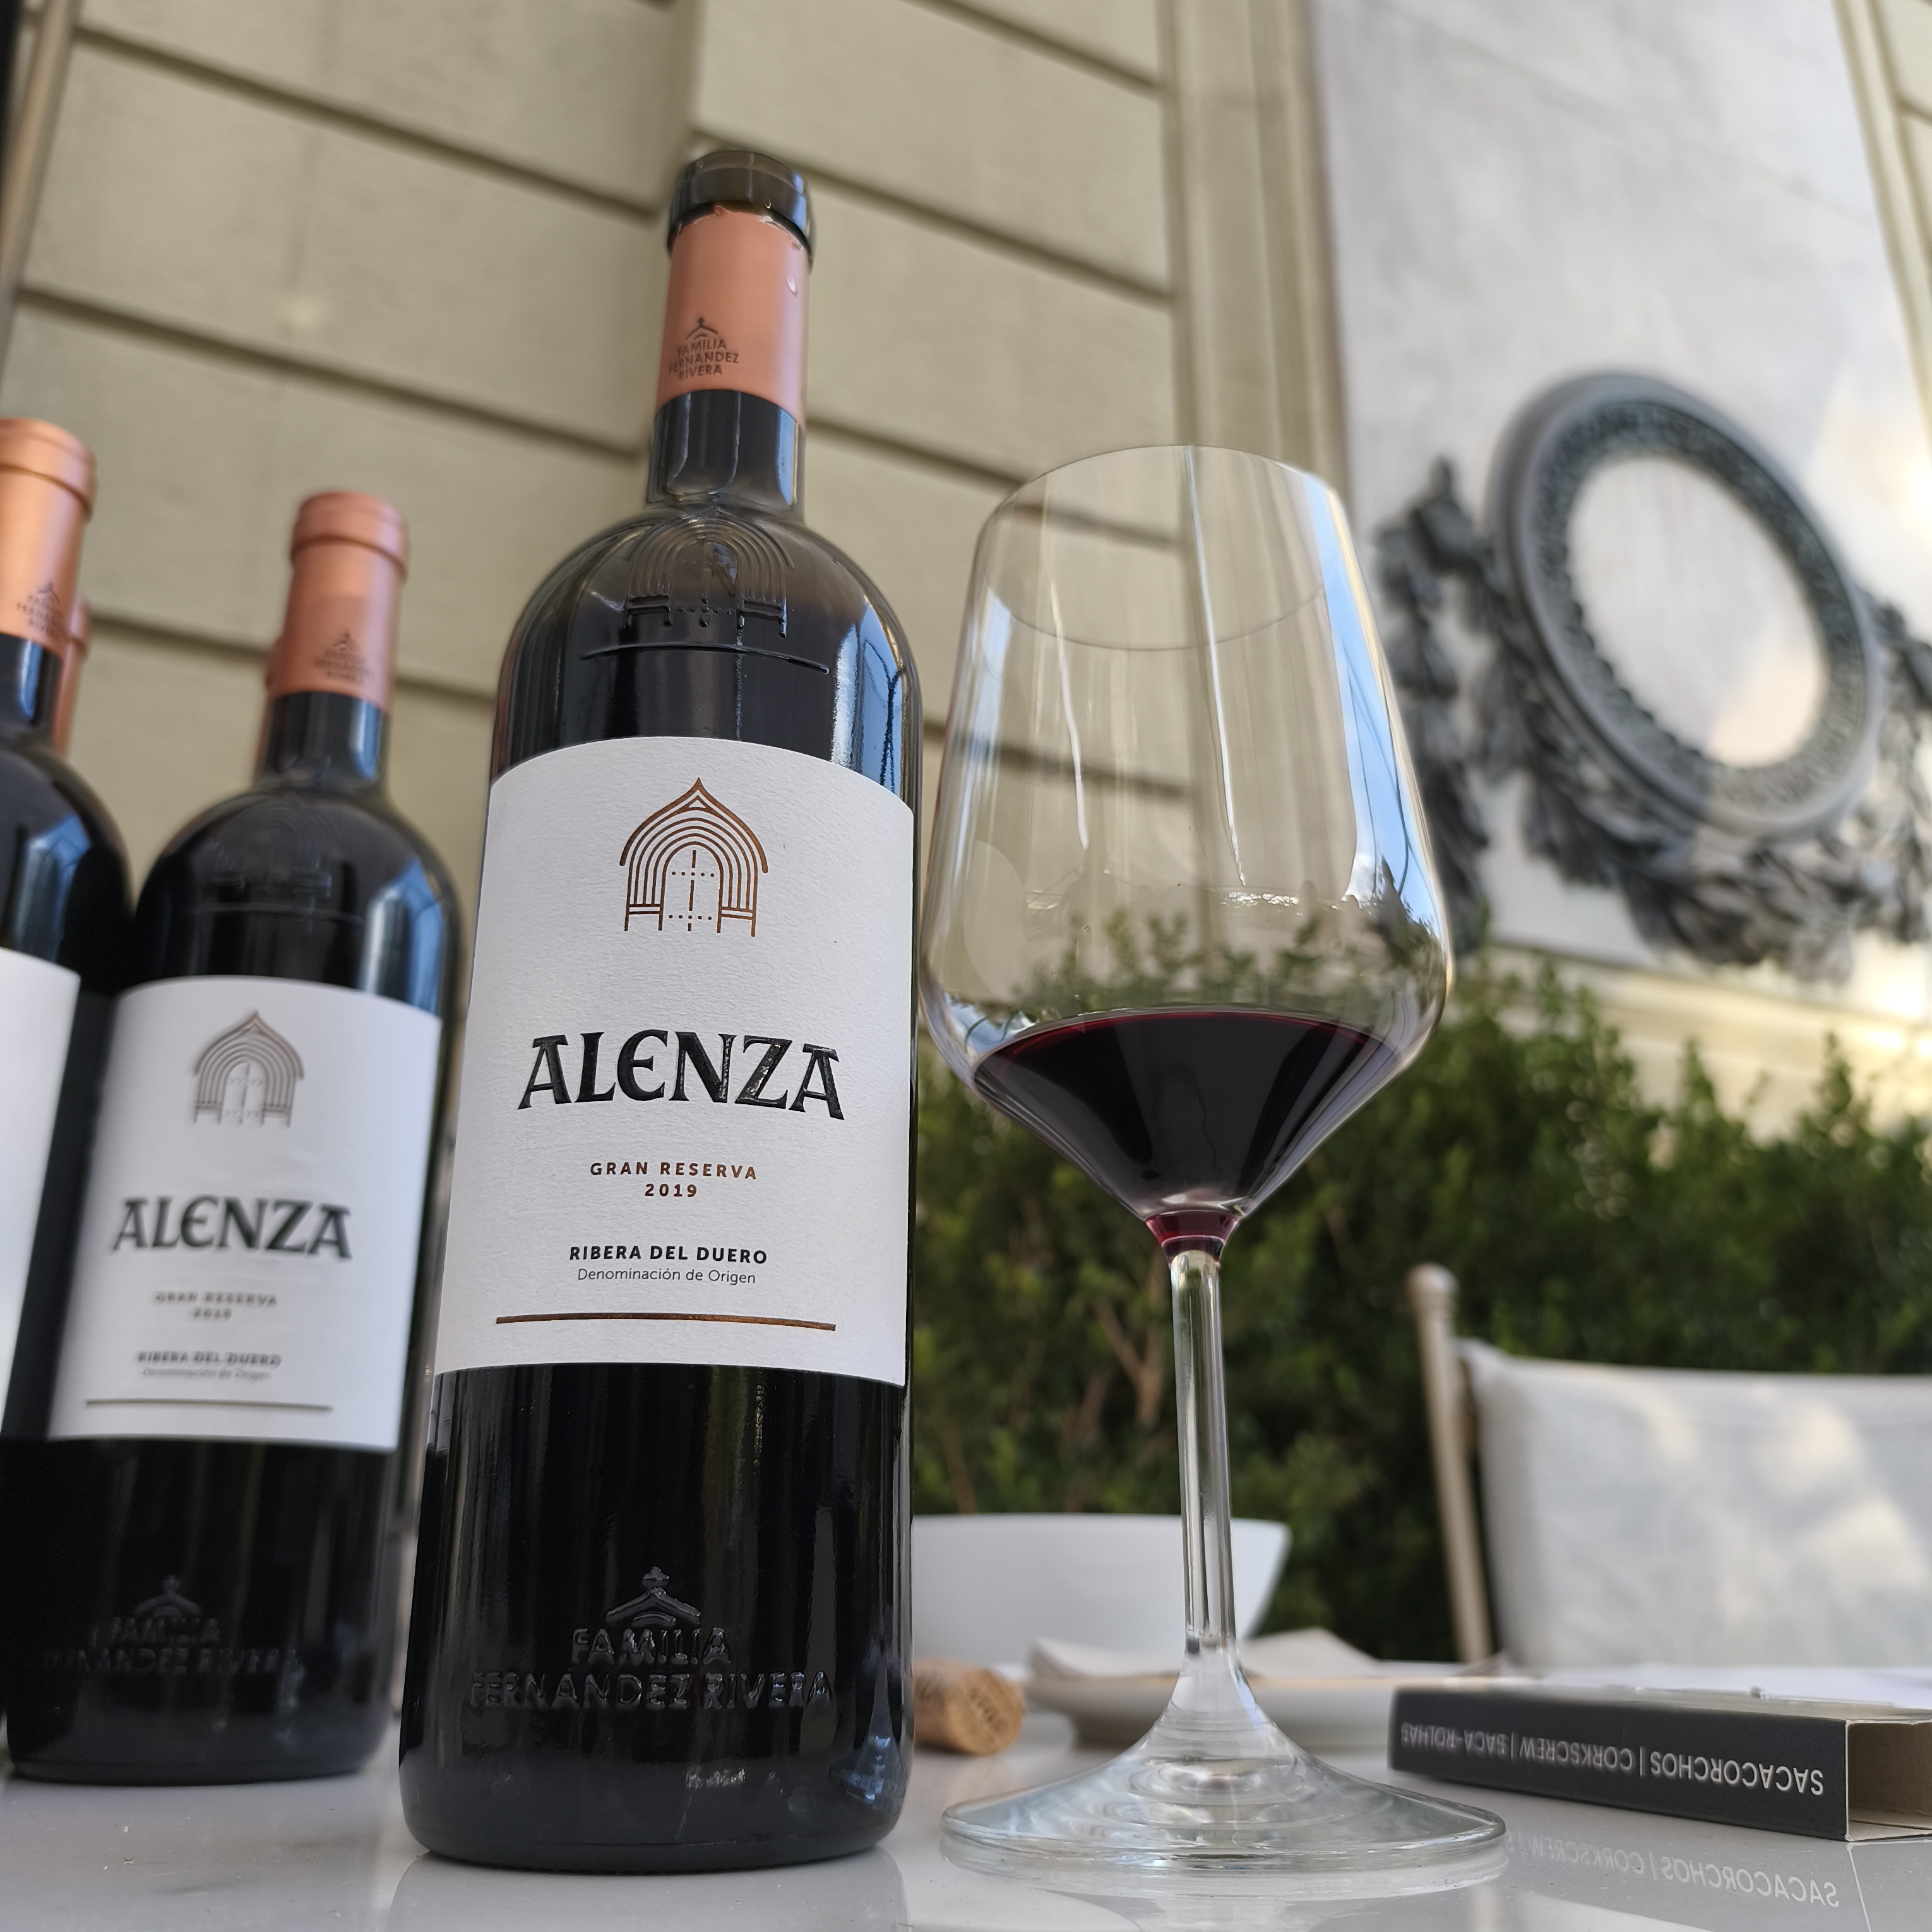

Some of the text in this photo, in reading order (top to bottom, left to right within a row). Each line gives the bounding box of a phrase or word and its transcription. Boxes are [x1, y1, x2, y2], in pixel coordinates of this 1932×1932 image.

[677, 338, 727, 358] FAMILIA
[669, 351, 739, 376] FERNANDEZ
[678, 364, 723, 381] RIVERA
[516, 1029, 845, 1121] ALENZA
[590, 1162, 757, 1180] GRAN RESERVA
[645, 1183, 698, 1198] 2019
[111, 1195, 352, 1260] ALENZA
[569, 1245, 768, 1265] RIBERA DEL DUERO
[577, 1268, 756, 1285] Denominación de Origen
[570, 1627, 732, 1666] FAMILIA
[469, 1671, 832, 1710] FERNANDEZ RIVERA
[1400, 1722, 1506, 1756] SACA-ROLHAS
[1519, 1736, 1633, 1771] CORKSCREW
[1650, 1751, 1824, 1796] SACACORCHOS
